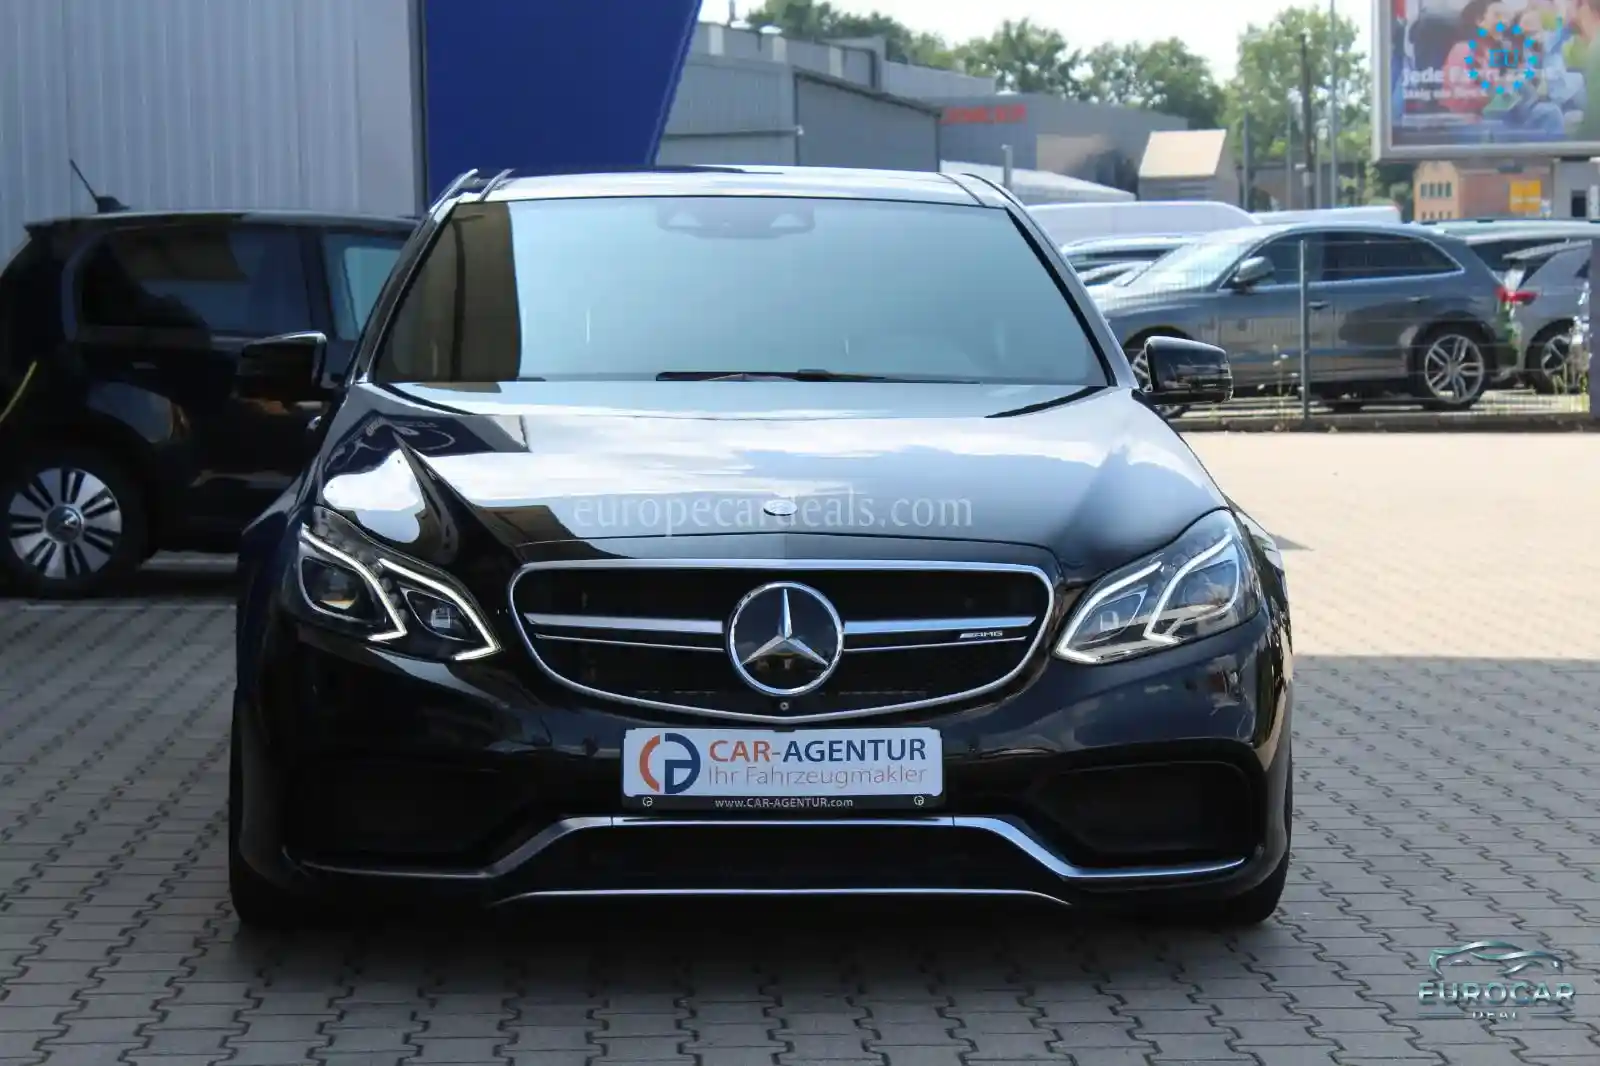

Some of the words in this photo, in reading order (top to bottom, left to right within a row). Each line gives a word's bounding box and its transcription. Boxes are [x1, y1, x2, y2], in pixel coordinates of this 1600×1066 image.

[709, 737, 927, 763] CAR-AGENTUR
[708, 766, 740, 785] Ihr
[746, 765, 927, 788] Fahrzeugmakler
[714, 796, 854, 809] www.CAR-AGENTUR.com
